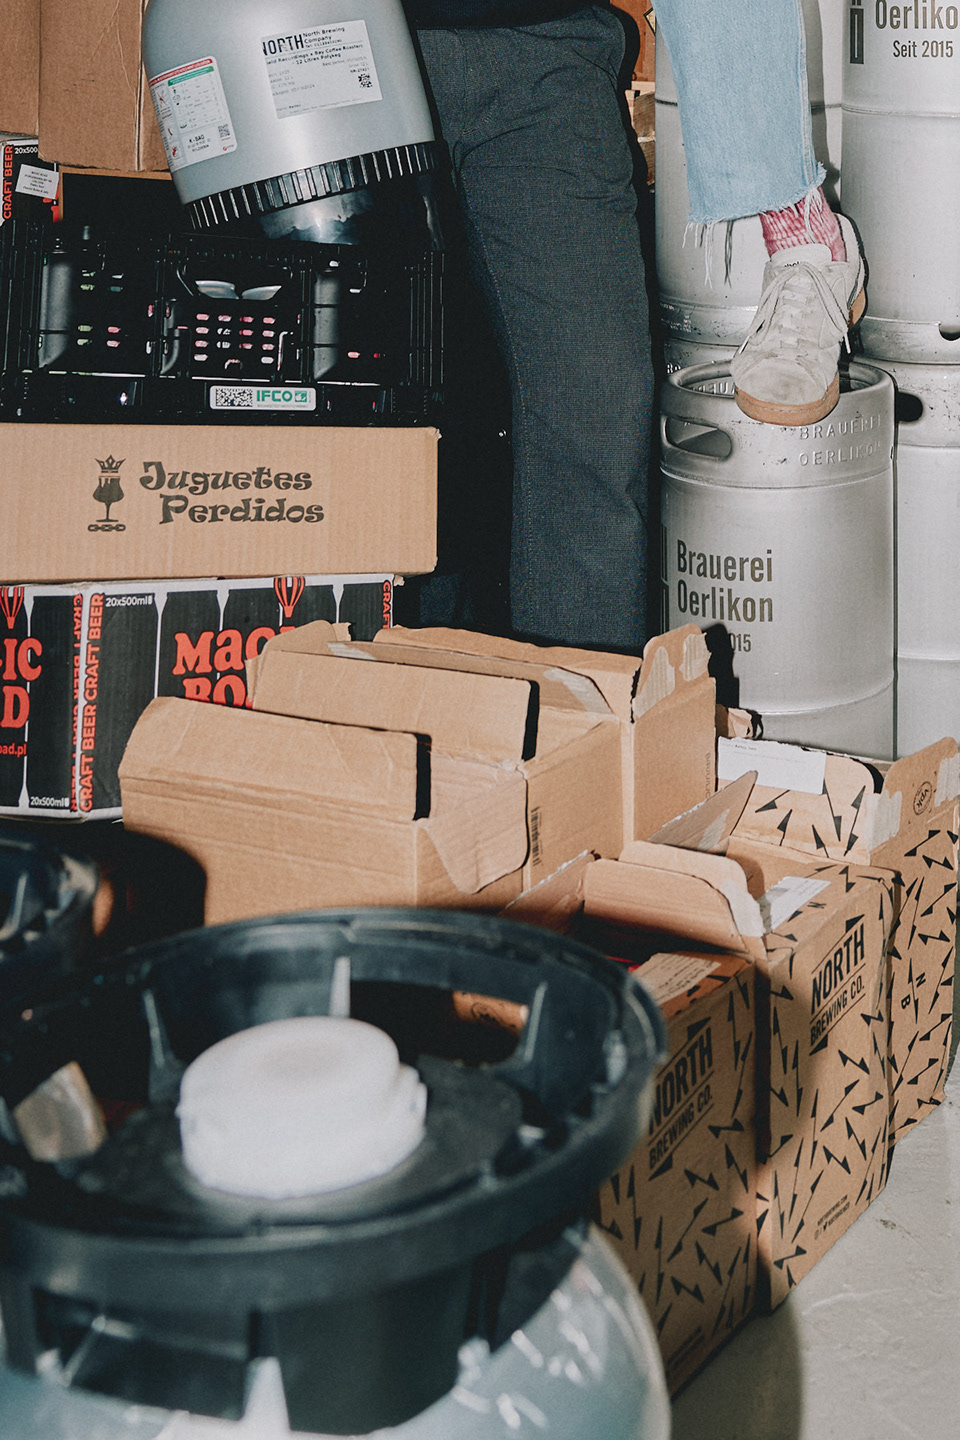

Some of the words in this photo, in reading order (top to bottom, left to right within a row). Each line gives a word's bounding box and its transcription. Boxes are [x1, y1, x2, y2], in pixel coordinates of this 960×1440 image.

[893, 40, 917, 58] Seit
[921, 40, 954, 58] 2015
[4, 145, 13, 177] BEER
[15, 146, 39, 155] 20x500
[3, 180, 13, 219] CRAFT
[257, 390, 293, 402] IFCO
[139, 461, 312, 496] Juguetes
[159, 493, 325, 525] Perdidos
[677, 539, 773, 583] Brauerei
[87, 593, 105, 640] BEER
[105, 595, 148, 608] 20x500ml
[677, 579, 774, 623] Oerlikon
[0, 637, 43, 681] IC
[83, 643, 101, 702] CRAFT
[81, 703, 97, 751] BEER
[30, 796, 65, 808] 20x500ml
[79, 754, 94, 812] CRAFT
[811, 922, 865, 1015] NORTH
[810, 988, 848, 1047] BREWING
[850, 975, 865, 1000] CO.
[649, 1026, 713, 1136] NORTH
[649, 1102, 695, 1171] BREWING
[697, 1084, 713, 1113] CO.
